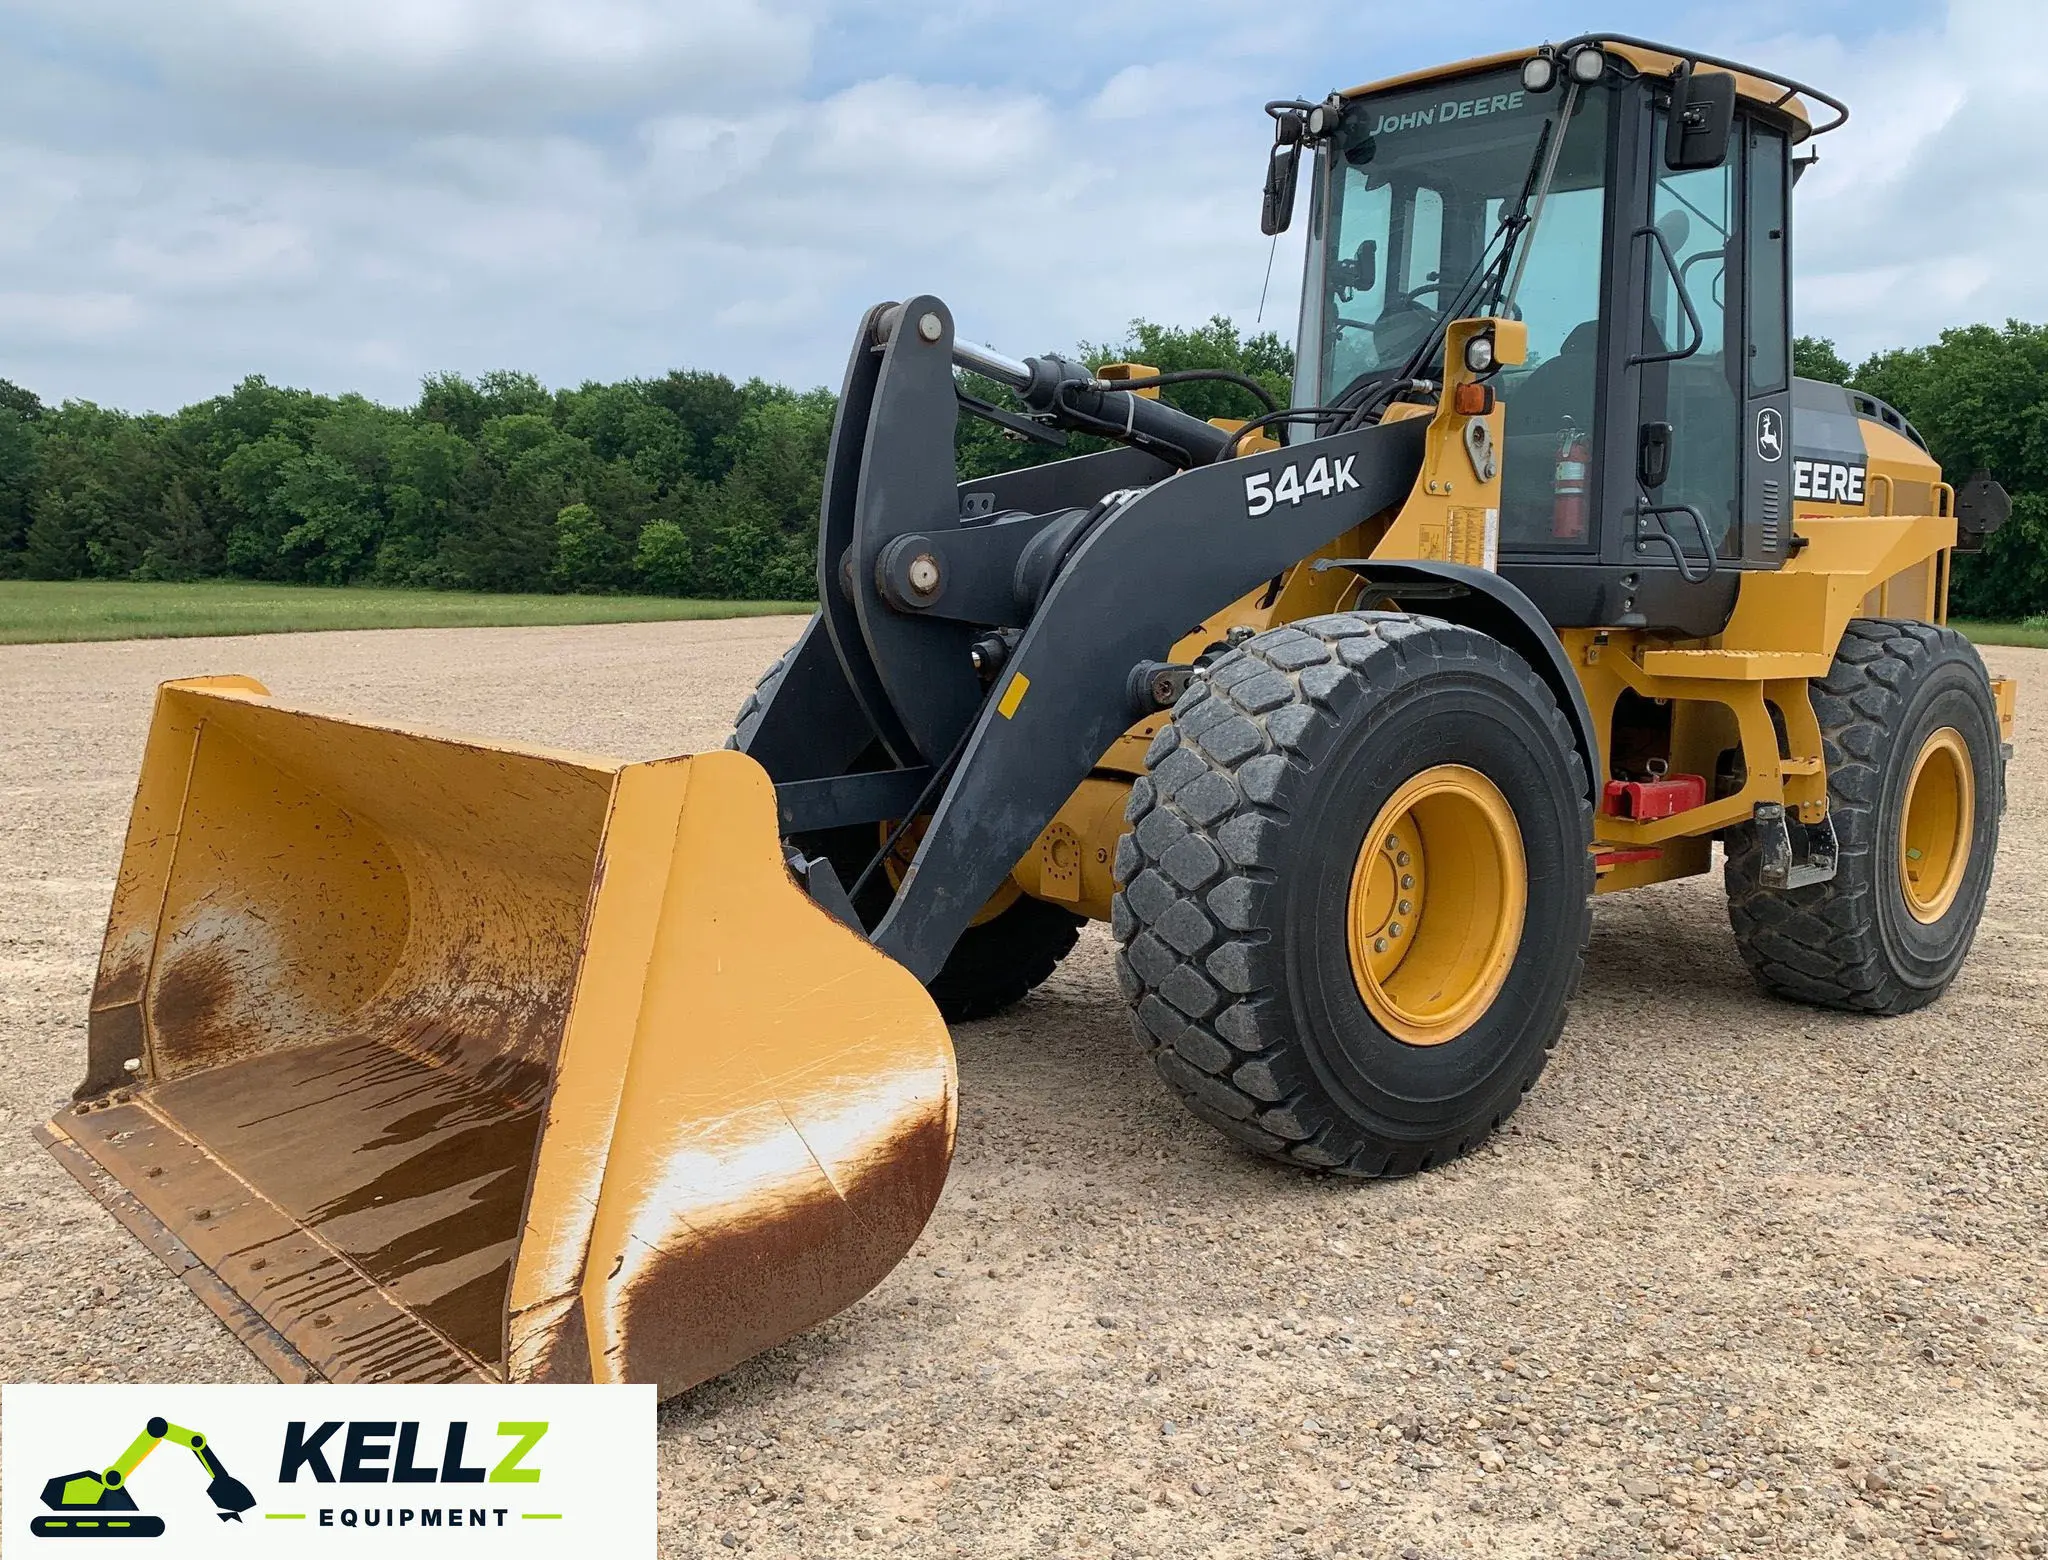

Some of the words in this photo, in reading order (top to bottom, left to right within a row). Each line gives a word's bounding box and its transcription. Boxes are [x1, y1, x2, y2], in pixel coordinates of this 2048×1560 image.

[1369, 107, 1435, 137] JOHN
[1439, 90, 1525, 123] DEERE
[1245, 453, 1360, 516] 544K
[1793, 460, 1866, 502] EERE
